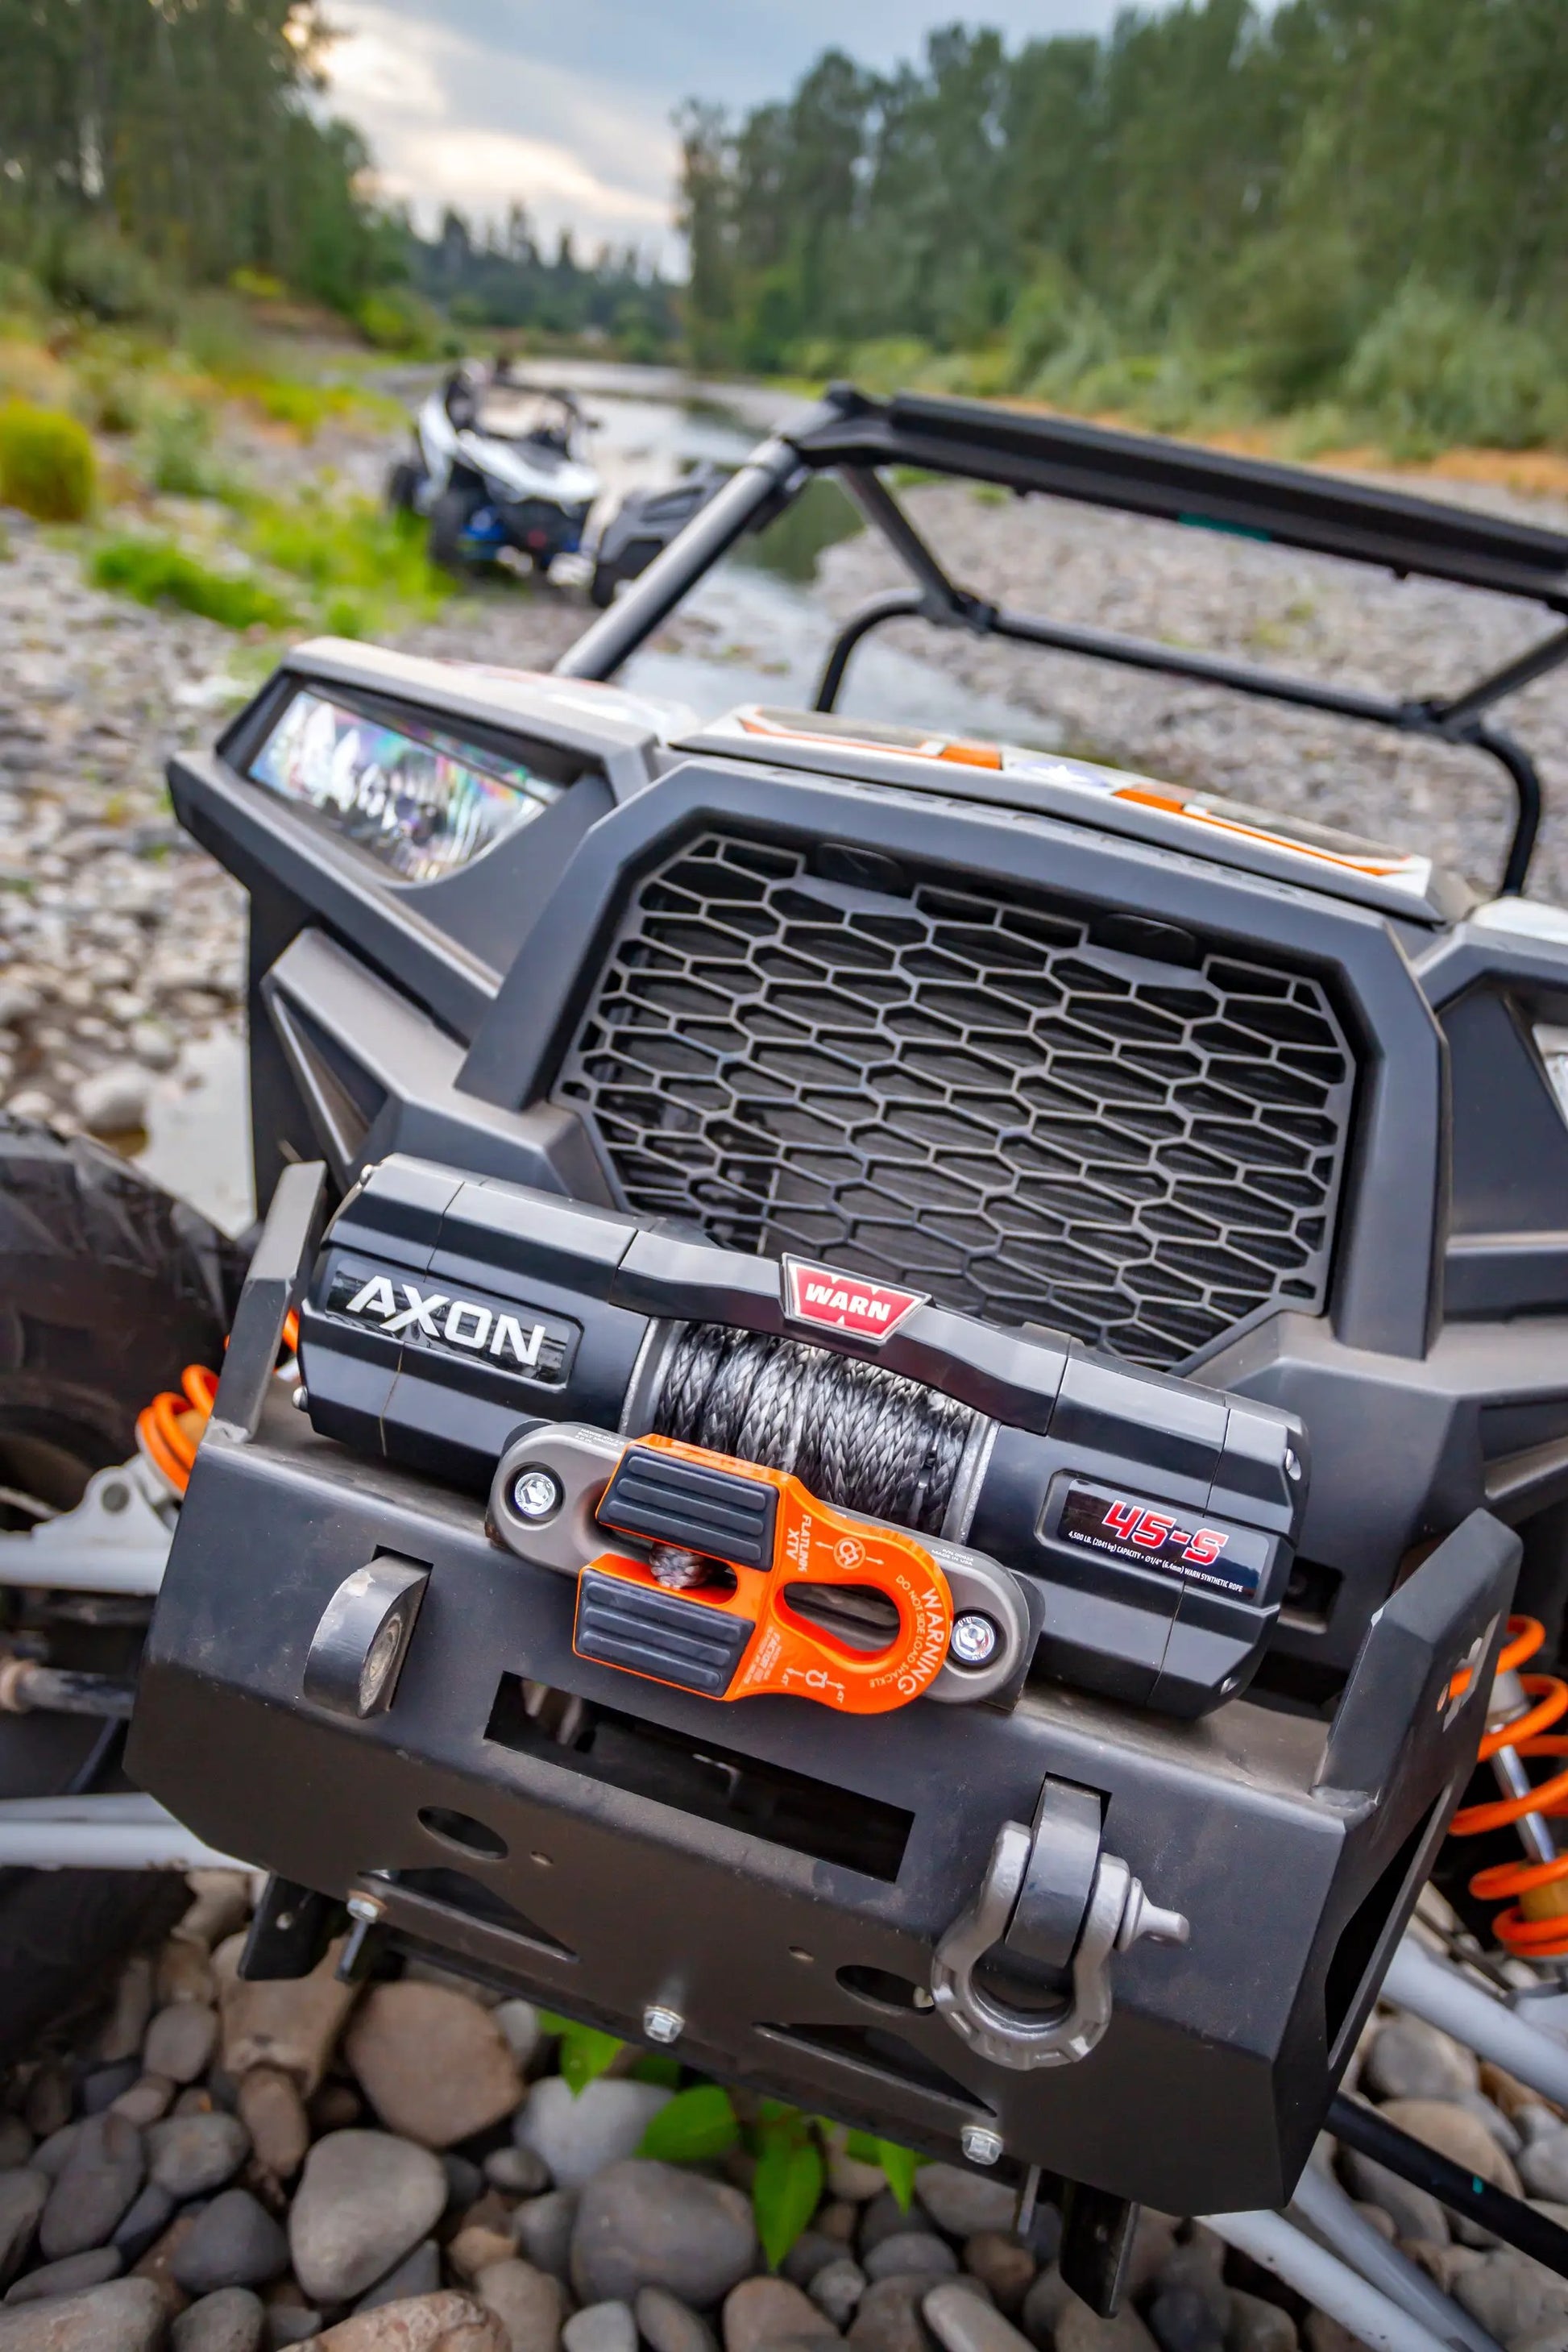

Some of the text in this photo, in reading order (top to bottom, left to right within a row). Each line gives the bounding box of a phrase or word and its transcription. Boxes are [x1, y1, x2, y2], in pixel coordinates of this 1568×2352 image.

[346, 1275, 546, 1367] AXON
[805, 1283, 891, 1322] WARN
[786, 1528, 799, 1560] XTV
[931, 1549, 950, 1559] MADE
[960, 1558, 973, 1566] USA
[1068, 1530, 1085, 1541] 4,500
[1083, 1535, 1092, 1544] LB.
[1092, 1537, 1109, 1549] (2041
[1107, 1543, 1117, 1553] kg)
[1117, 1545, 1141, 1559] CAPACITY
[1162, 1560, 1184, 1574] (6.4mm)
[1184, 1568, 1201, 1579] WARN
[1201, 1573, 1229, 1588] SYNTHETIC
[1228, 1583, 1243, 1593] ROPE
[1101, 1500, 1230, 1566] 45-S
[869, 1574, 926, 1688] DO NOT SIDE LOAD SHACKLE
[897, 1587, 944, 1695] WARNING
